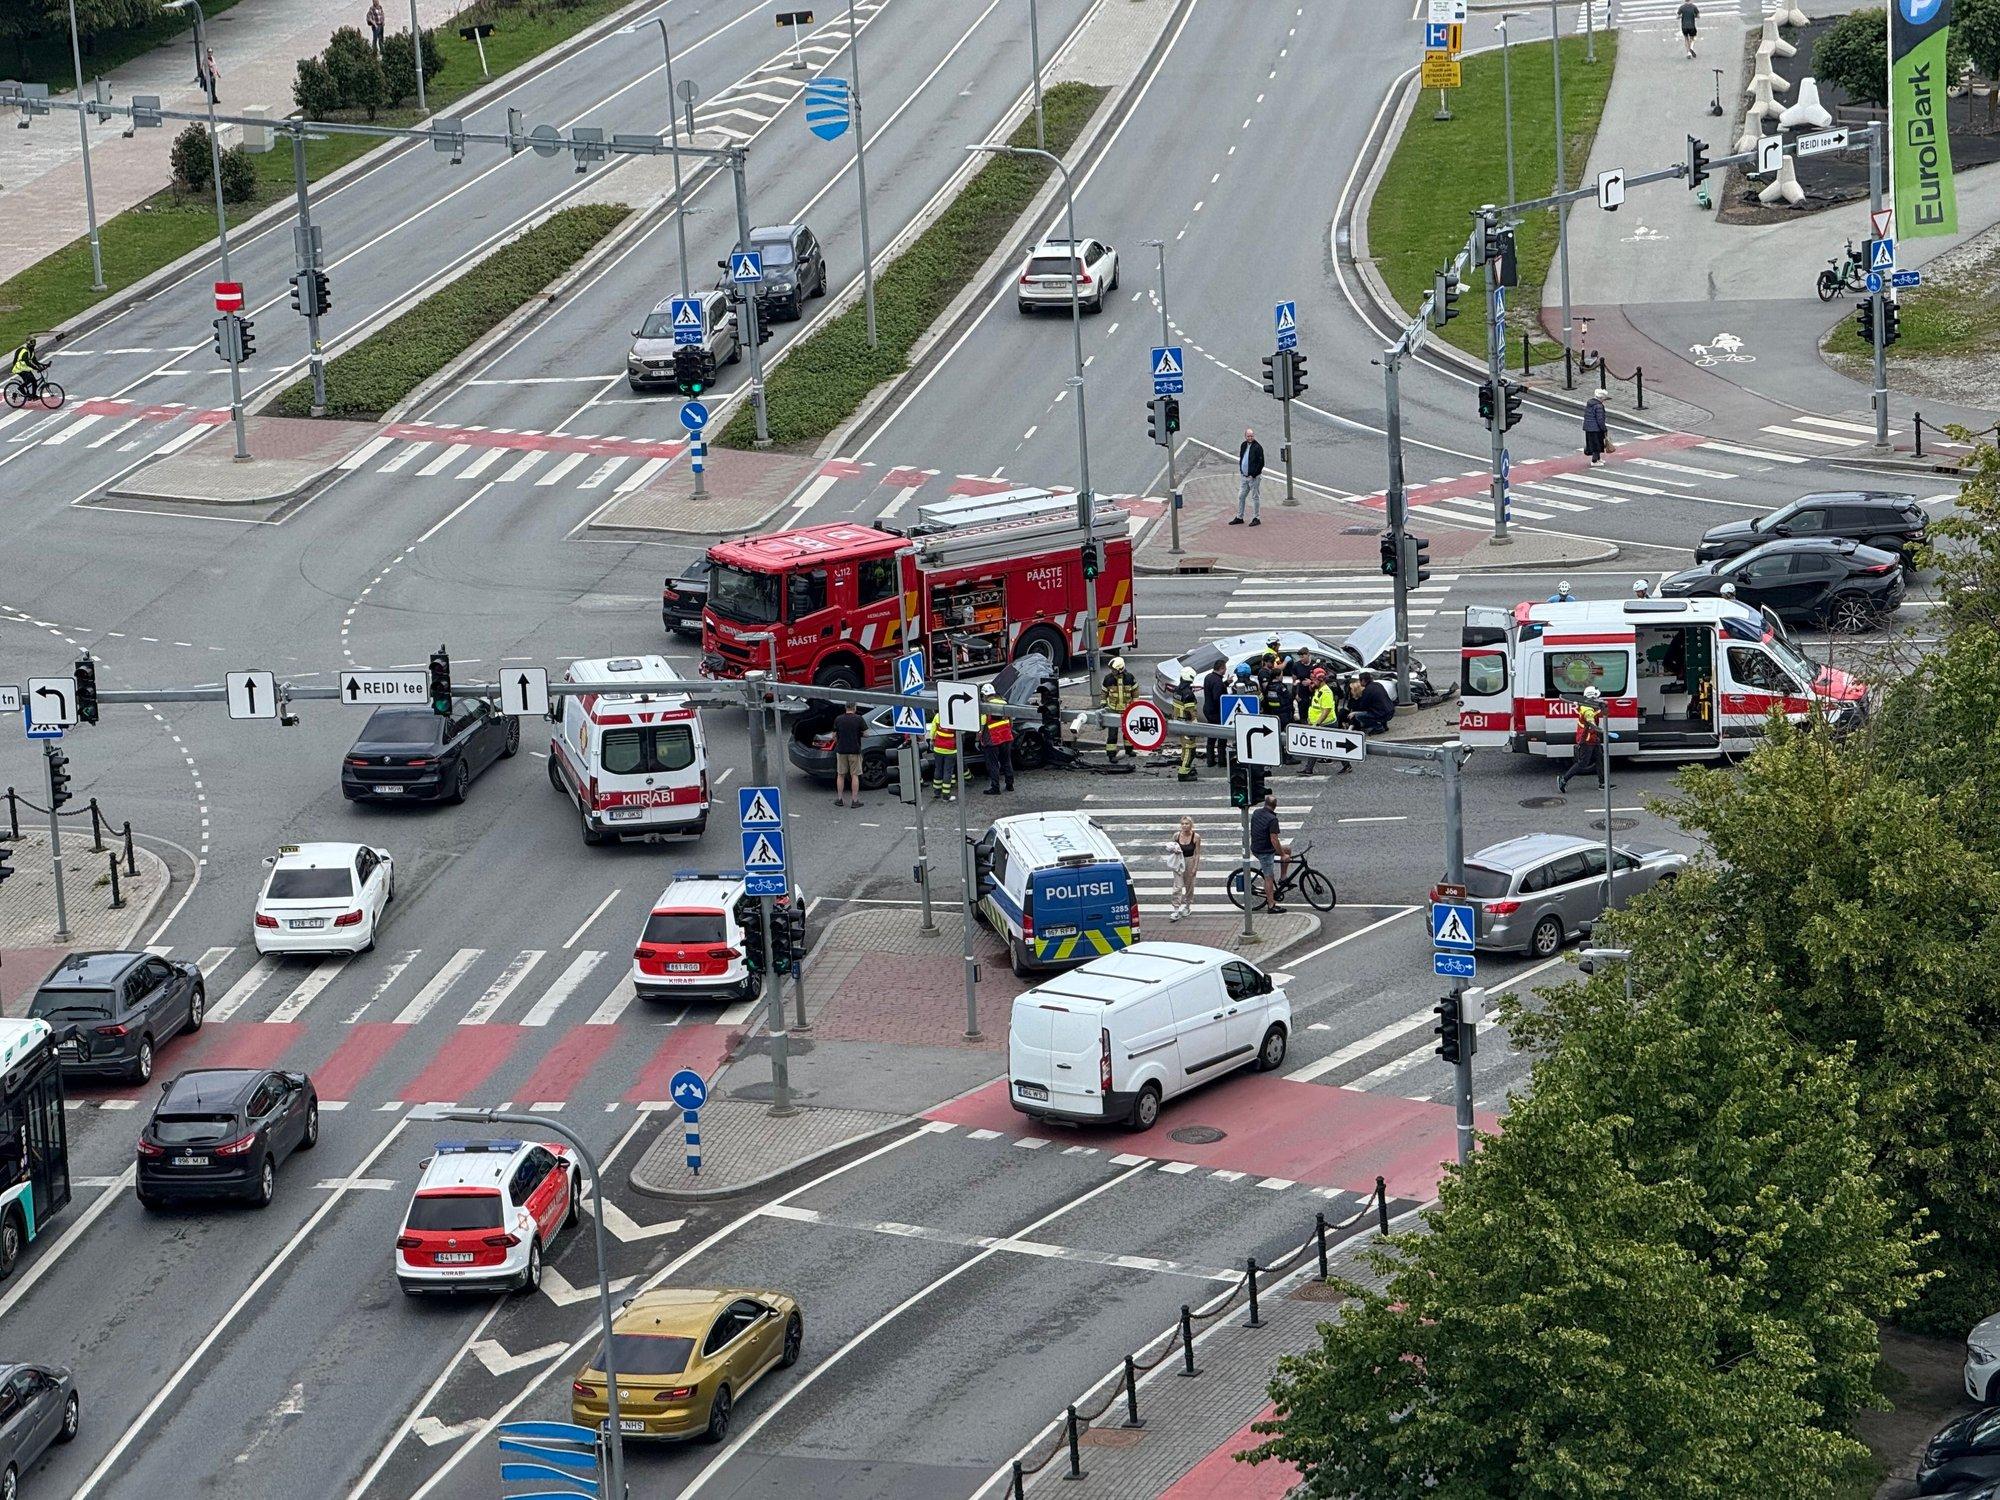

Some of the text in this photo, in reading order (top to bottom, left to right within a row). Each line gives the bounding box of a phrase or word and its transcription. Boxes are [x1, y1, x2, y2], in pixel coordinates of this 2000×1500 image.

[1800, 137, 1832, 151] REIDI tee
[1908, 61, 1944, 225] EuroPark
[1027, 566, 1062, 581] PÄÄSTE
[1046, 578, 1063, 589] 112
[787, 633, 818, 648] PÄÄSTE
[363, 682, 423, 694] REIDI tee
[2, 693, 15, 705] tn
[1142, 717, 1156, 728] 15t
[1292, 731, 1333, 751] JÕE tn
[600, 793, 611, 801] 23
[622, 791, 675, 805] KIIRABI
[1045, 881, 1115, 901] POLITSEI
[1110, 904, 1130, 914] 3285
[439, 1253, 472, 1262] 641 TYT
[625, 1421, 643, 1429] NHS
